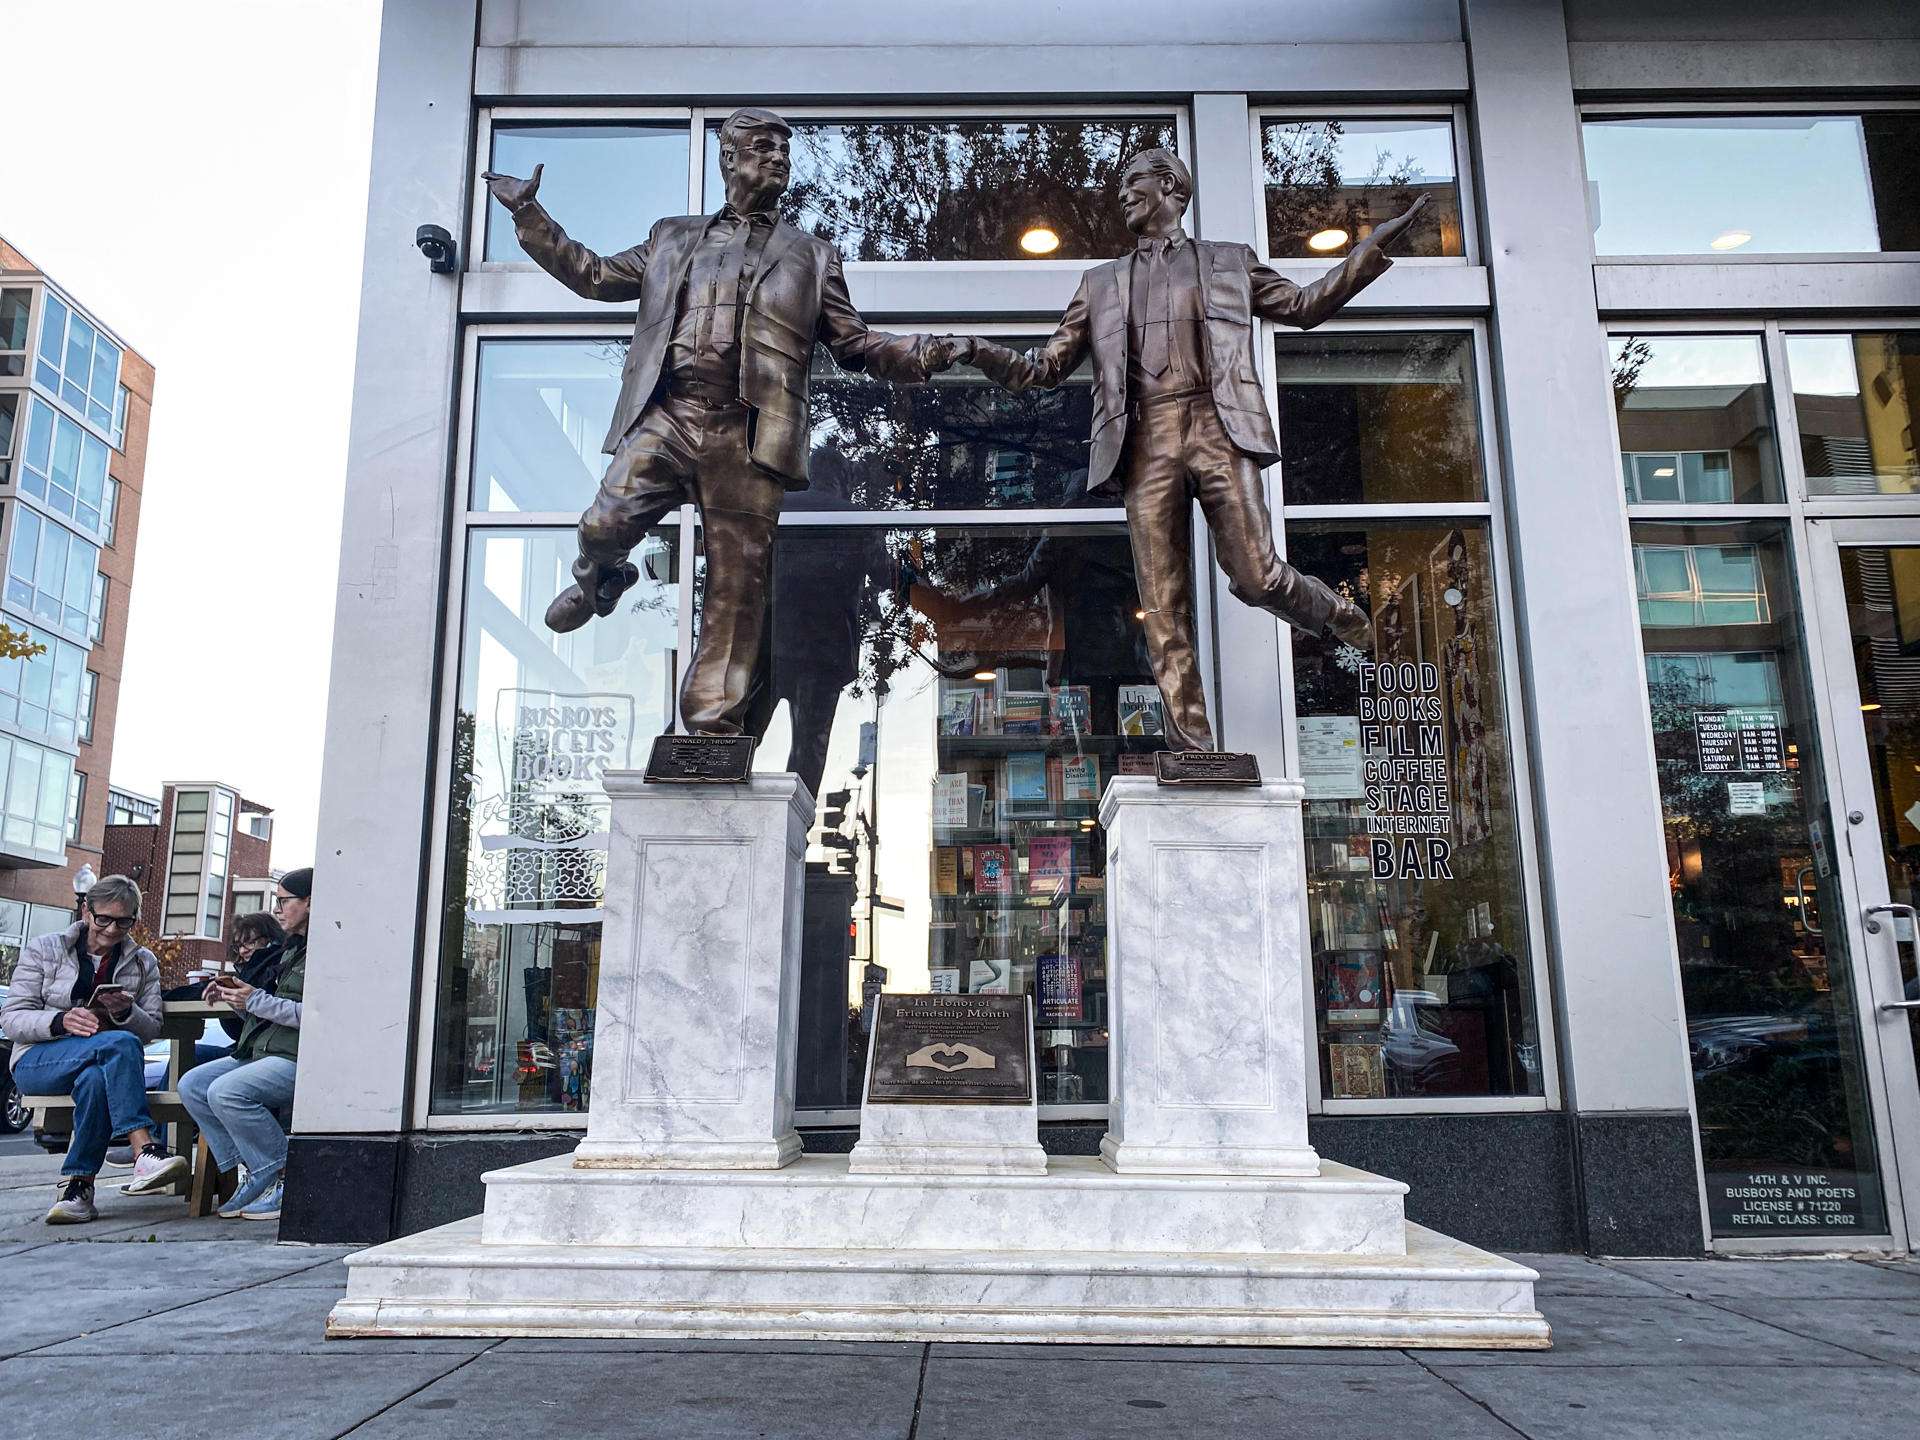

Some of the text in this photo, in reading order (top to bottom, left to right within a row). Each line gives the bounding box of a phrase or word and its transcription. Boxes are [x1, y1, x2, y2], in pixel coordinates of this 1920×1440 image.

[1358, 662, 1439, 693] FOOD
[519, 705, 617, 729] BUSBOYS
[1359, 696, 1442, 721] BOOKS
[1362, 725, 1444, 756] FILM
[513, 754, 611, 782] BOOKS
[1363, 759, 1447, 782] COFFEE
[1365, 785, 1449, 812] STAGE
[1367, 815, 1450, 834] INTERNET
[1370, 837, 1454, 880] BAR
[896, 1008, 1010, 1019] Friendship Month
[914, 998, 991, 1007] In Honor of
[1748, 1175, 1830, 1185] 14TH & V INC.
[1726, 1188, 1856, 1198] BUSBOYS AND POETS
[1743, 1201, 1841, 1211] LICENSE # 71220
[1732, 1214, 1856, 1224] RETAIL CLASS: CR02
